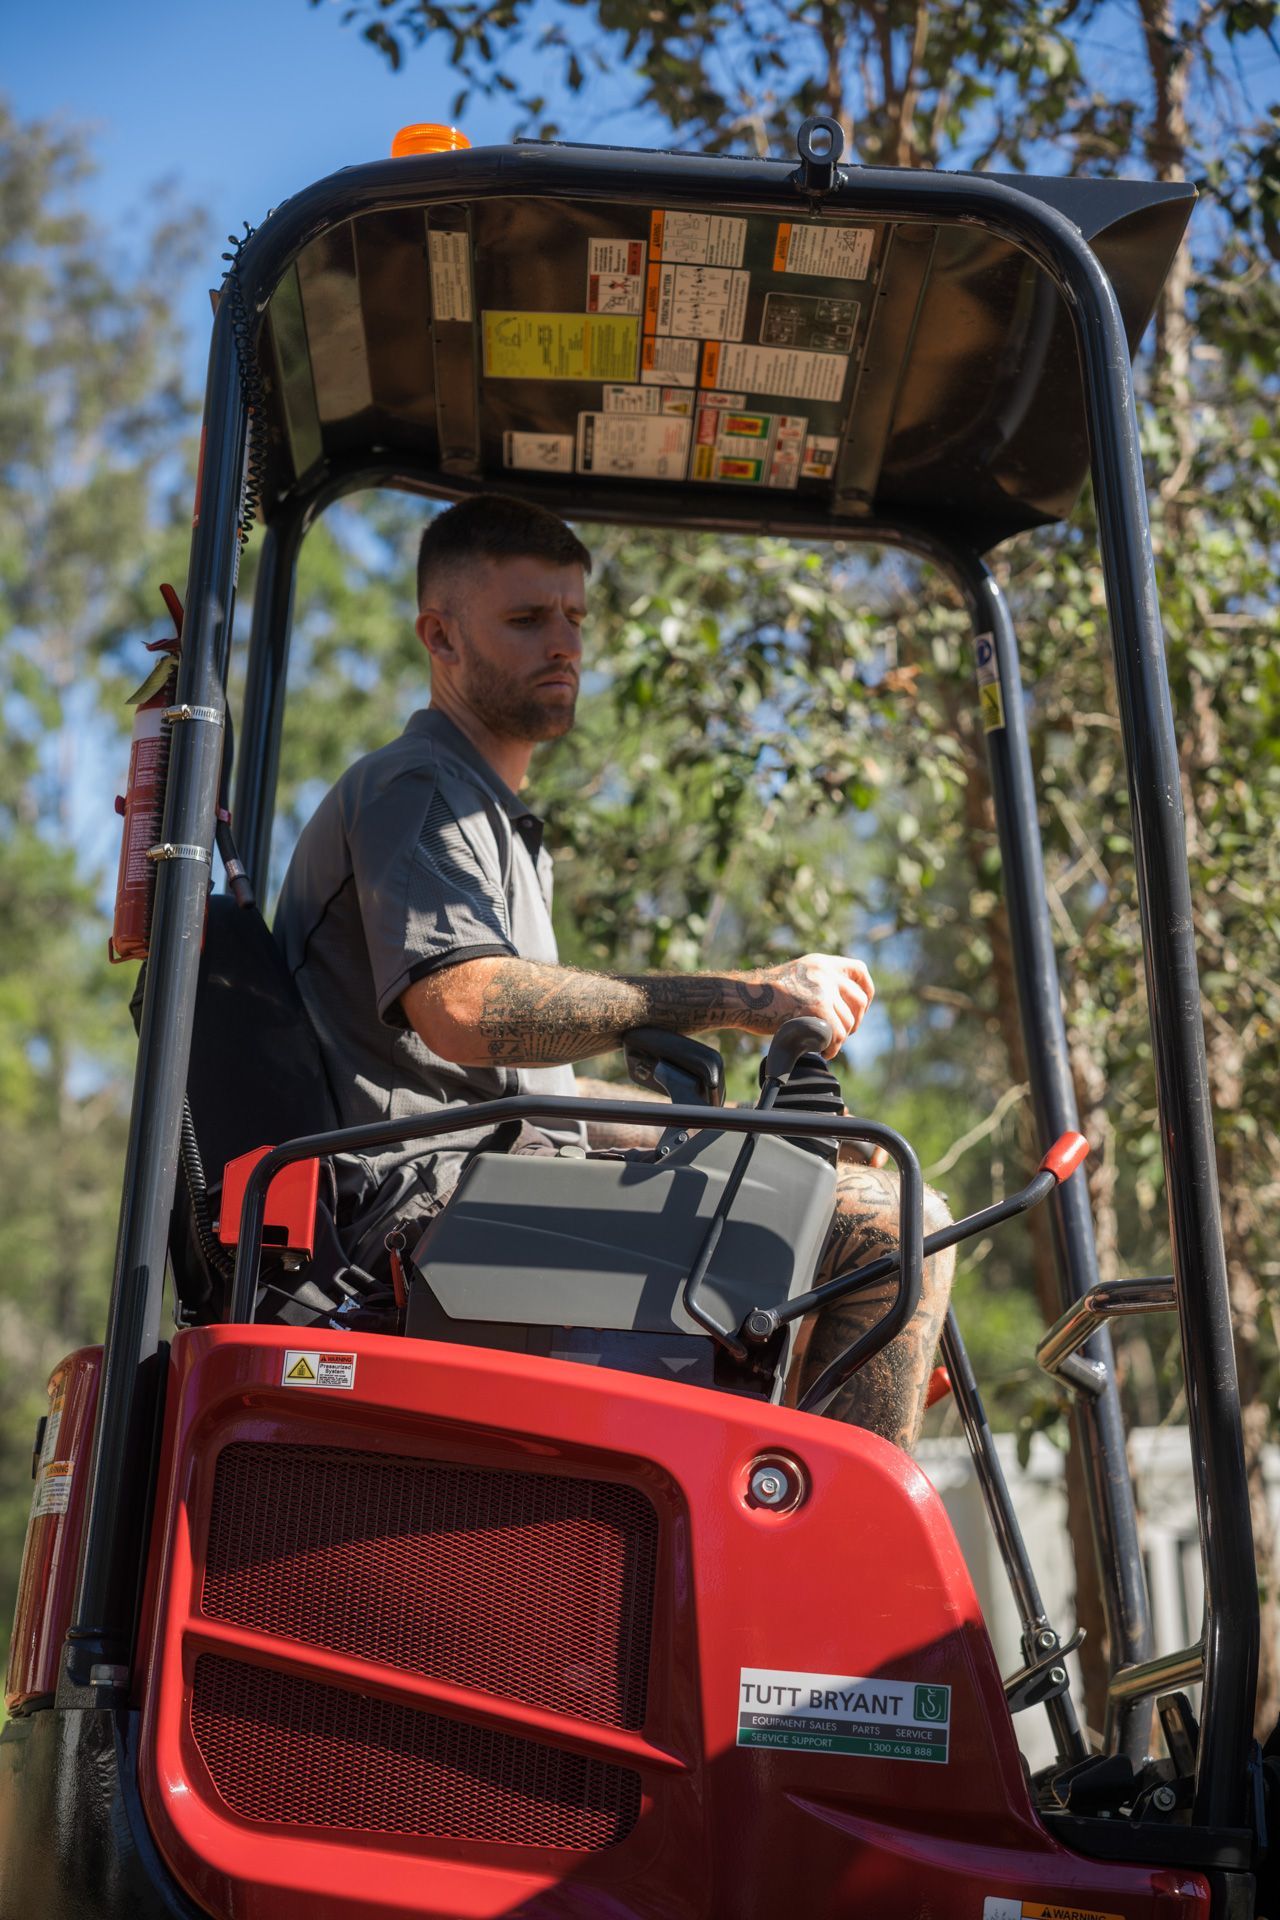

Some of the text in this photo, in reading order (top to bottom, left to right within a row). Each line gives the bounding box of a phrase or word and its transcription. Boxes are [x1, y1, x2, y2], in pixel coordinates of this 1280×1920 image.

[742, 1683, 904, 1716] TUTT BRYANT
[752, 1715, 933, 1740] EQUIPMENT SALES PARTS SERVICE
[751, 1732, 933, 1757] SERVICE SUPPORT 1300 658 888
